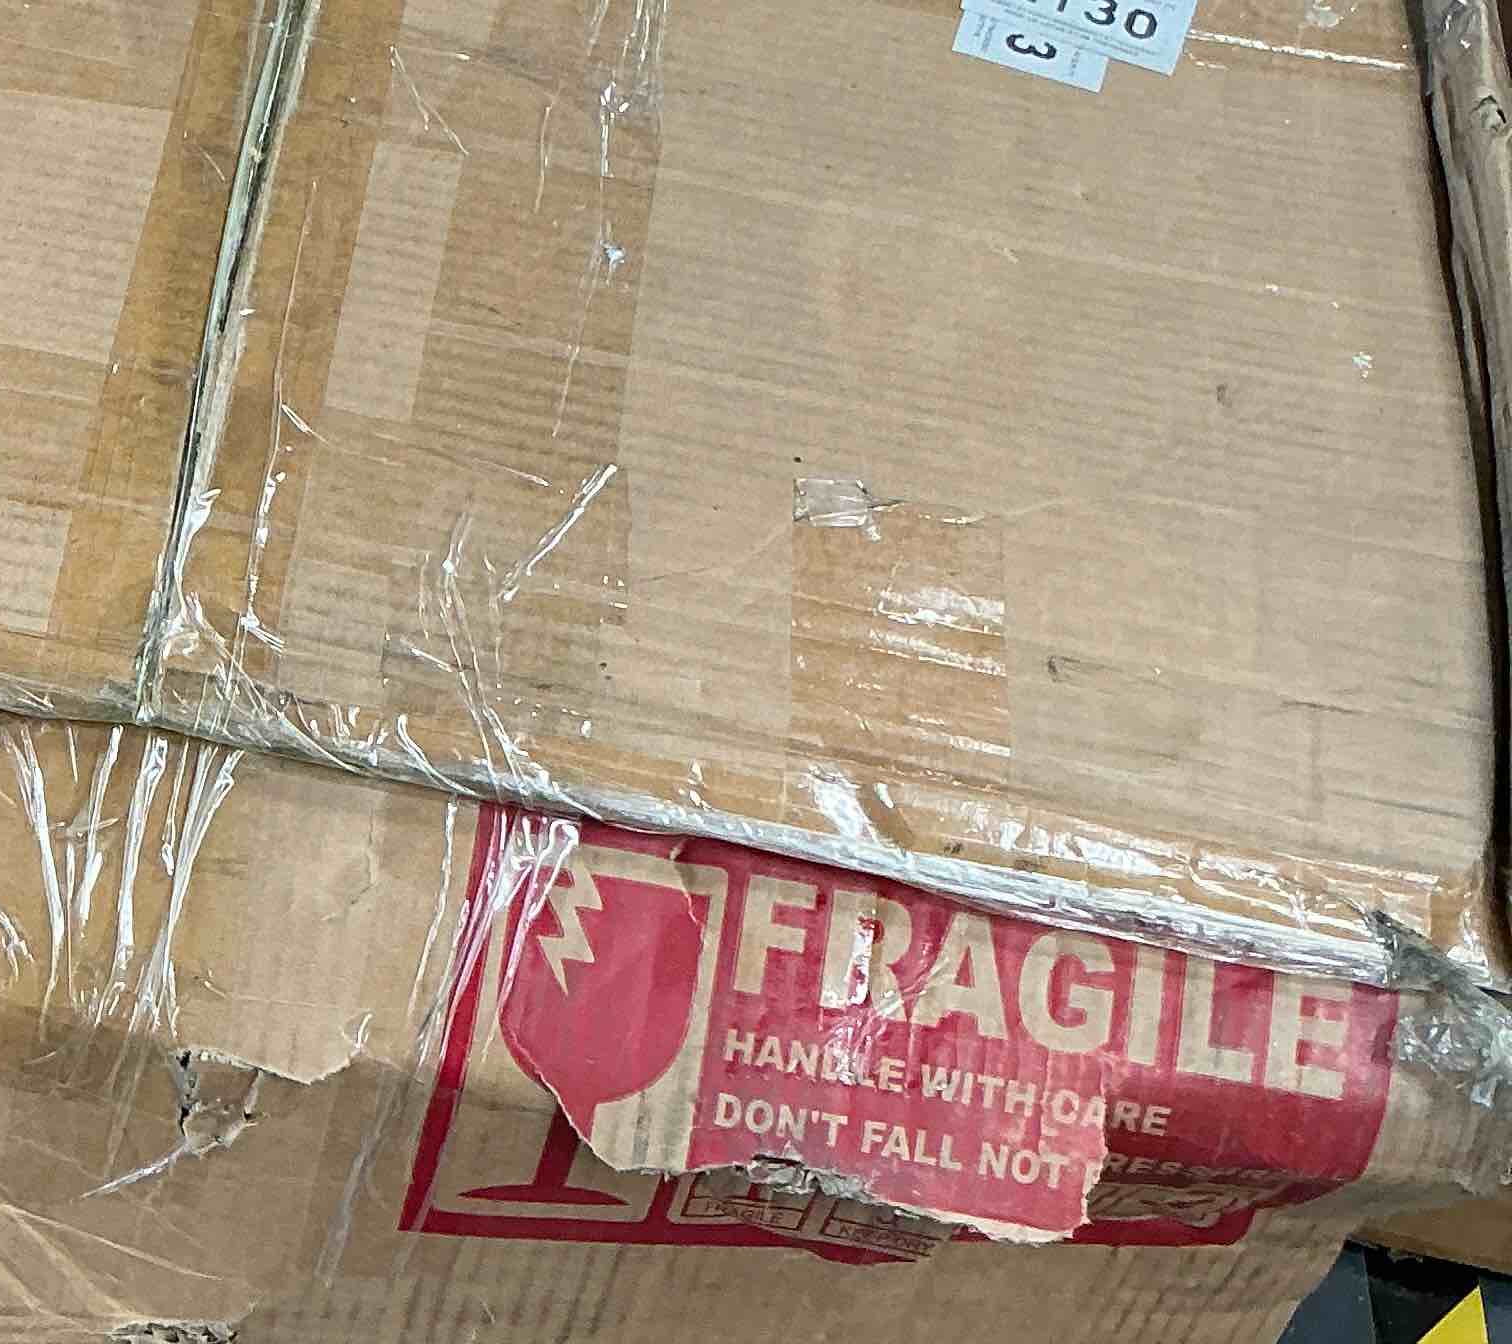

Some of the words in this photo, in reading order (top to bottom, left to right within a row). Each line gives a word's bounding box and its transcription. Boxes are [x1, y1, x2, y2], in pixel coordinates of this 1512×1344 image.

[732, 870, 1356, 1102] FRAGILE
[712, 1091, 849, 1149] DON'T
[859, 1118, 964, 1172] FALL
[978, 1142, 1070, 1191] NOT
[920, 1062, 1038, 1117] WITH
[1050, 1088, 1173, 1138] CARE
